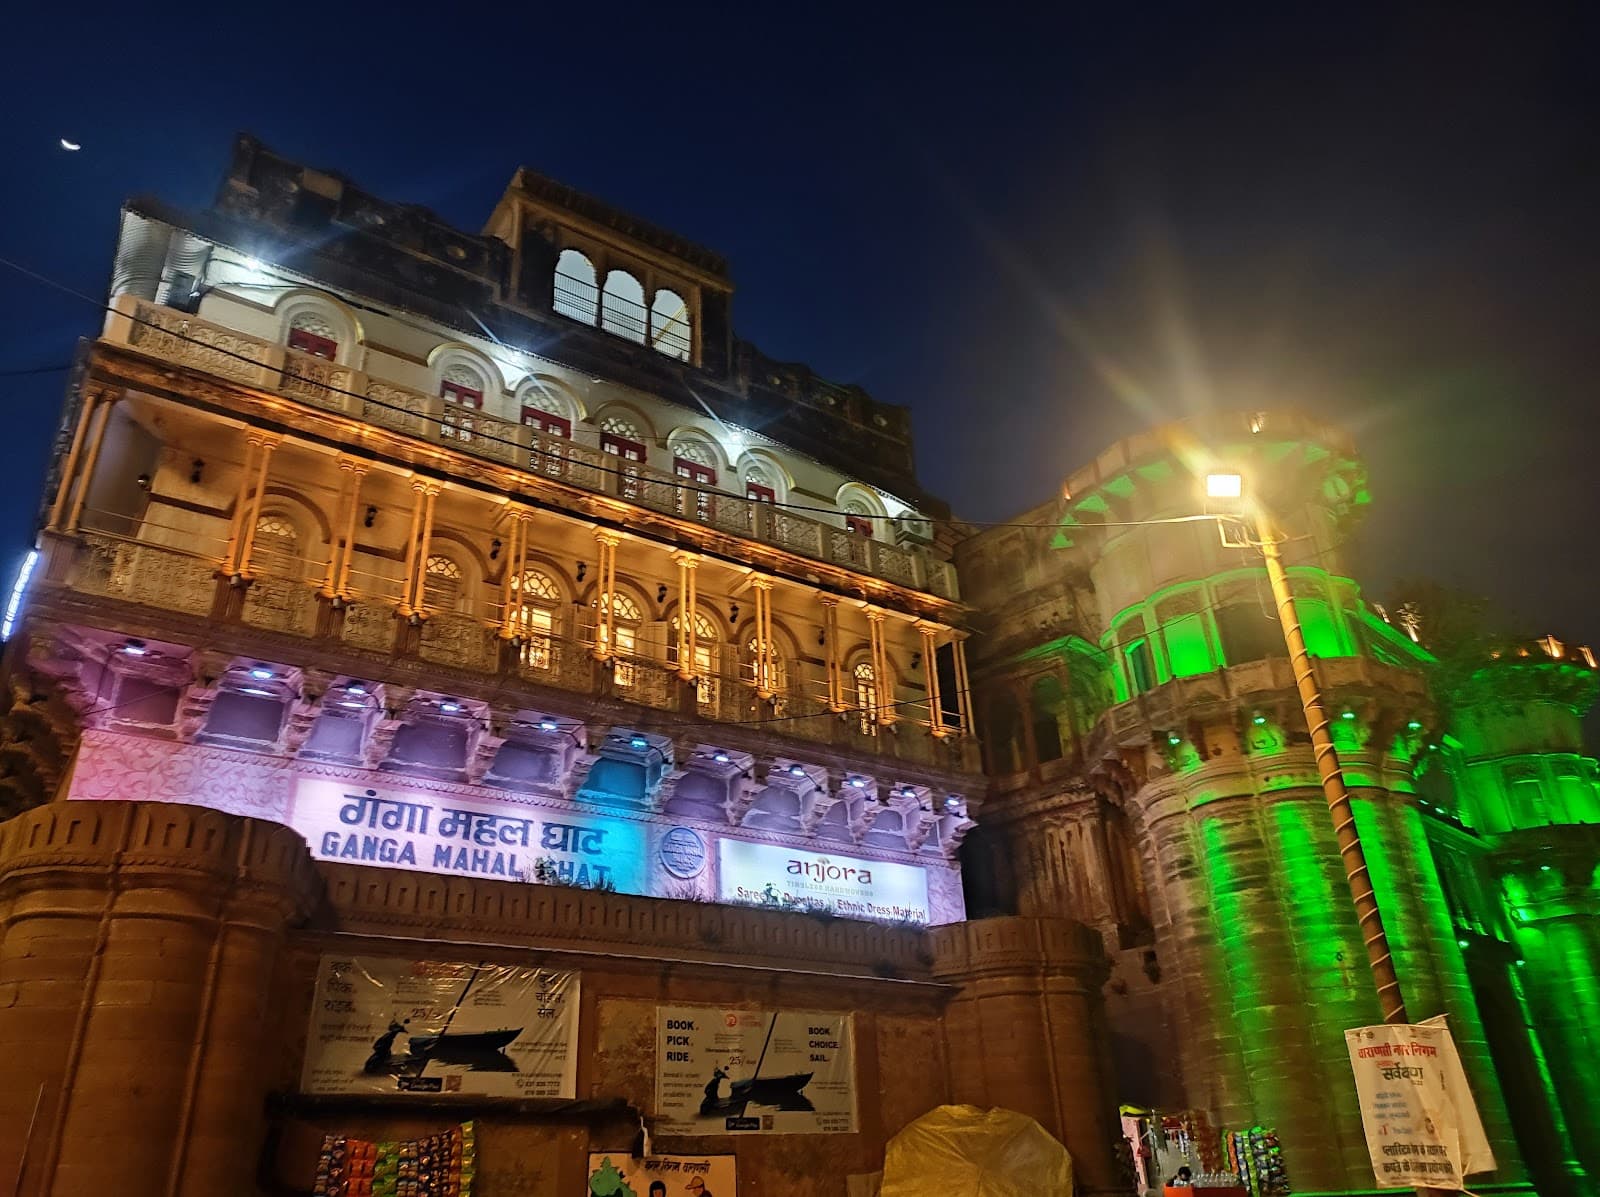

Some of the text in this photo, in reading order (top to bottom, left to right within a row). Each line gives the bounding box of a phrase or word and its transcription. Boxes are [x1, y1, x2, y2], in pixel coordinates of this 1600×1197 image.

[339, 789, 608, 855] गंगा महल घाट
[321, 831, 611, 888] GANGA MAHAL HAT
[786, 859, 873, 885] anjora
[837, 899, 866, 913] Ethnic
[866, 902, 891, 917] Dress
[892, 906, 925, 921] Material
